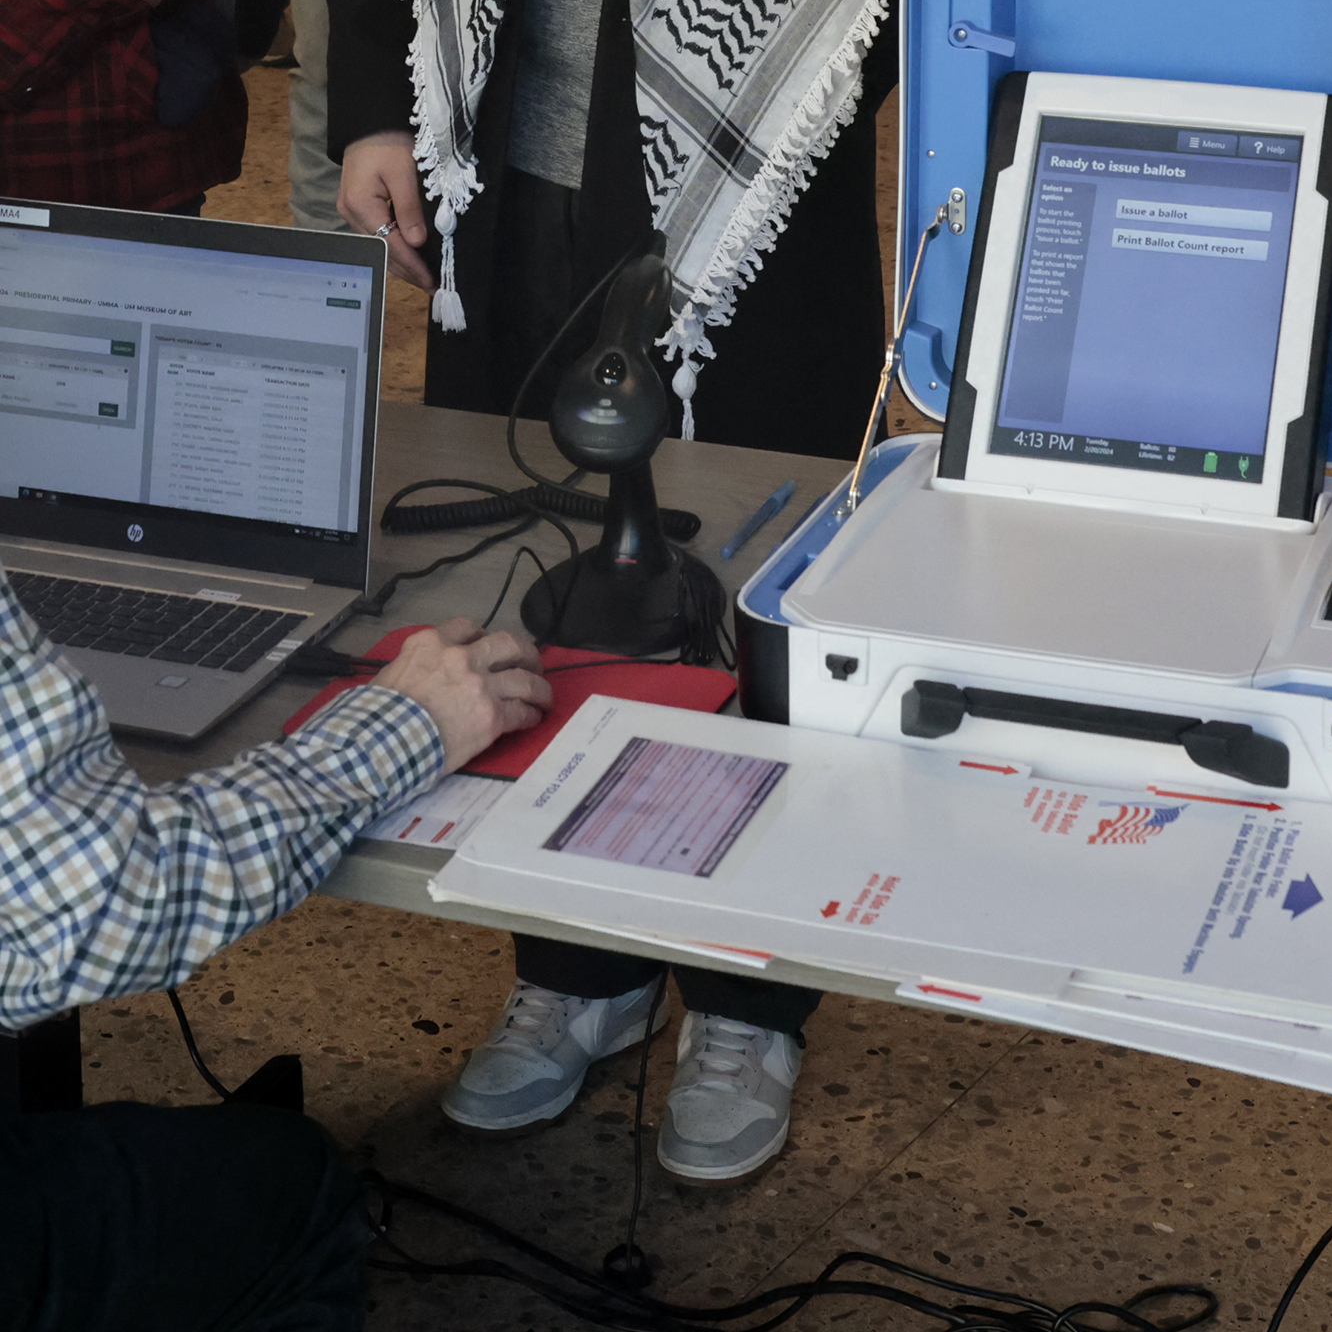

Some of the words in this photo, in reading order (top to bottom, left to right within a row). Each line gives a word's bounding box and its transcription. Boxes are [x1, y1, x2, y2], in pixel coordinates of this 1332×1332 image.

[1202, 139, 1226, 150] Menu
[1266, 145, 1286, 155] Help
[1050, 155, 1089, 172] Ready
[1092, 158, 1106, 171] to
[1108, 161, 1141, 174] issue
[1143, 162, 1187, 178] ballots
[1042, 184, 1063, 192] Select
[1041, 194, 1064, 202] option
[1039, 207, 1047, 215] To
[1121, 205, 1147, 216] Issue
[1158, 208, 1188, 220] ballot
[1037, 217, 1056, 225] ballot
[1062, 228, 1082, 236] touch
[1117, 234, 1143, 246] Print
[1145, 237, 1175, 248] Ballot
[1177, 240, 1209, 251] Count
[1211, 244, 1245, 255] report
[1032, 249, 1041, 257] To
[1041, 251, 1057, 259] print
[1030, 258, 1044, 266] that
[1066, 262, 1078, 270] the
[1051, 270, 1066, 278] that
[1028, 276, 1044, 285] have
[1044, 278, 1061, 286] been
[1026, 286, 1050, 294] printed
[14, 290, 61, 303] PRESIDENTIAL
[62, 296, 93, 306] PRIMARY
[97, 300, 119, 309] UMMA
[124, 303, 136, 311] UM
[136, 305, 167, 314] MUSEUM
[168, 308, 178, 316] OF
[178, 310, 193, 318] ART
[1025, 295, 1044, 303] touch
[1024, 303, 1043, 312] Ballot
[1043, 306, 1064, 314] Count
[1013, 430, 1044, 448] 4:13
[1048, 433, 1075, 451] PM
[128, 524, 143, 541] hp
